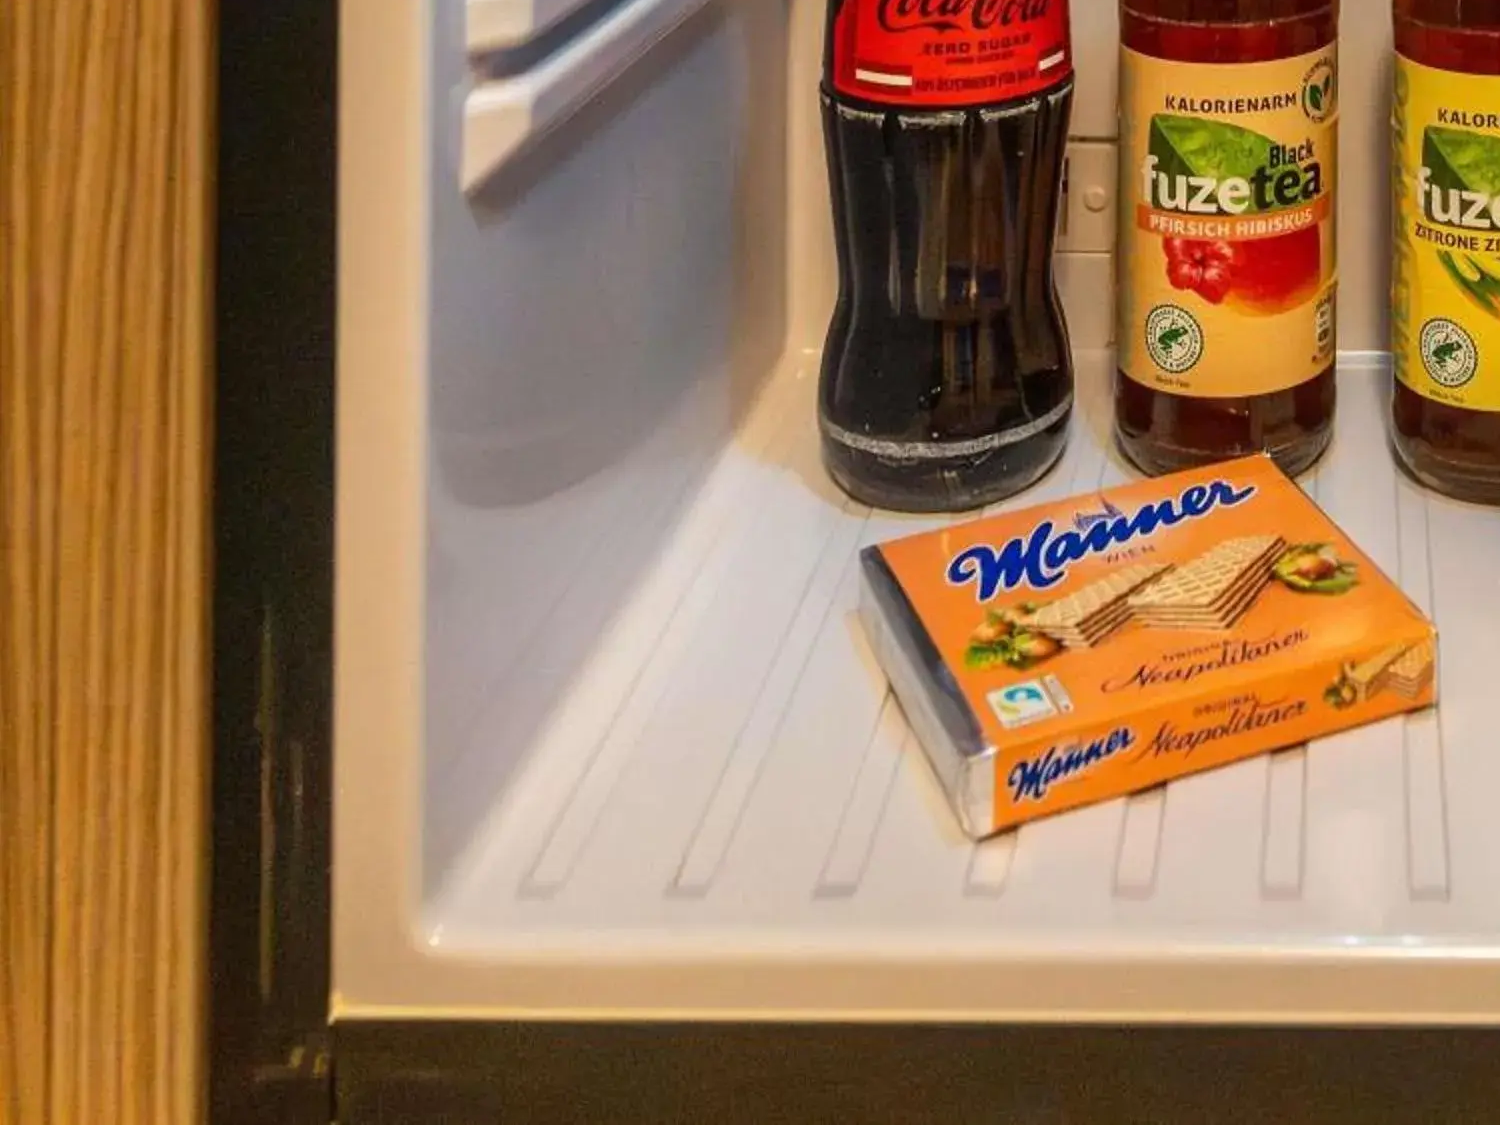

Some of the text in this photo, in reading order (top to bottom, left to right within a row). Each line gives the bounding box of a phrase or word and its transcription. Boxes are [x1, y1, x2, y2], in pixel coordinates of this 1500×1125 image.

[922, 32, 1032, 56] ZERO SUGAR
[1164, 90, 1297, 114] KALORIENARM
[1269, 138, 1314, 169] Black
[1150, 207, 1313, 238] PFIRSICH HIBISKUS
[1415, 221, 1480, 252] ZITRONE
[949, 479, 1255, 601] Manner
[1106, 544, 1156, 564] WIEN
[1100, 632, 1309, 694] Neapolitaner
[1129, 697, 1308, 765] Neapolitaner
[1007, 727, 1136, 803] Manner
